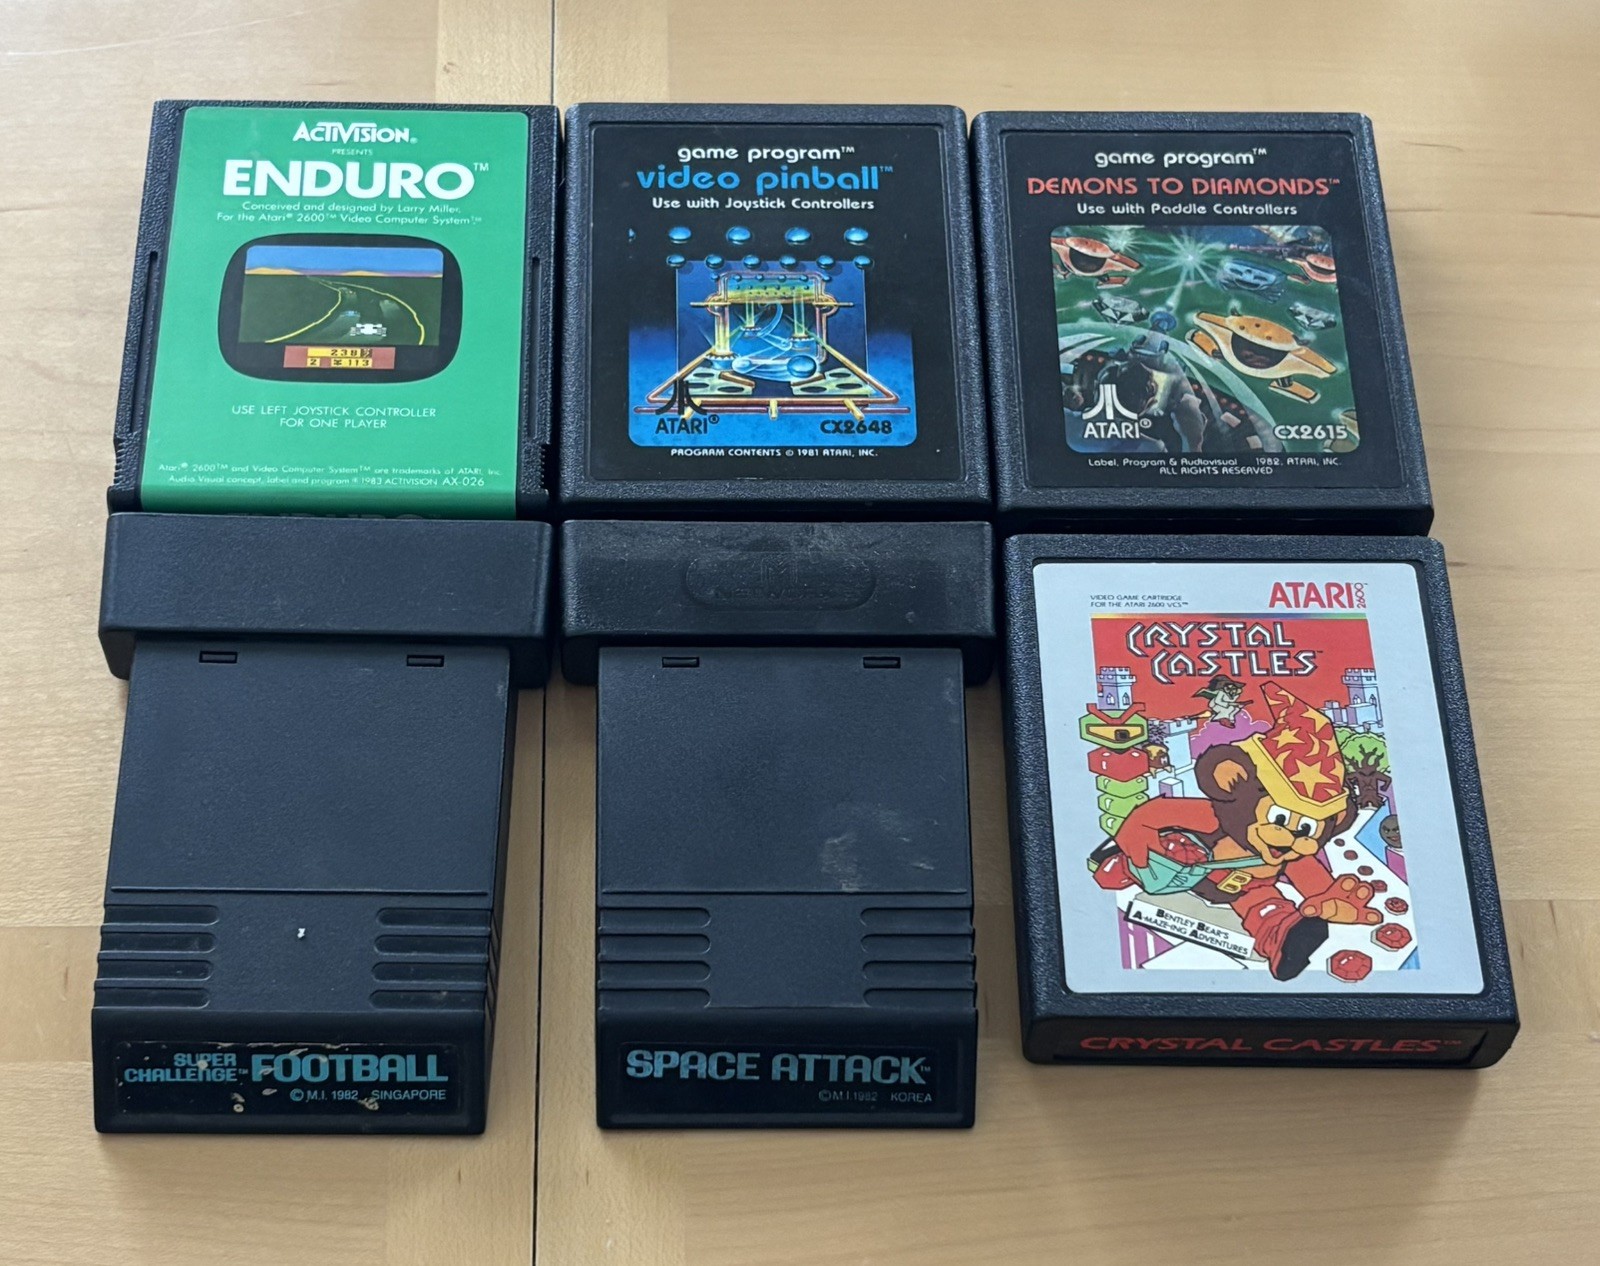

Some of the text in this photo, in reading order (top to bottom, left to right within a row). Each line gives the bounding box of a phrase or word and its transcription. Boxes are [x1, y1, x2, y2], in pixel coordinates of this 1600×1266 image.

[332, 148, 373, 156] PRESENTS
[677, 147, 739, 162] game
[1095, 151, 1155, 168] game
[636, 164, 740, 190] video
[1027, 177, 1138, 195] DEMONS
[1147, 178, 1183, 195] TO
[242, 201, 300, 211] Conceived
[303, 203, 325, 211] and
[328, 203, 377, 214] designed
[380, 203, 394, 214] by
[397, 204, 425, 214] Larry
[652, 197, 874, 212] Use with Joystick Controllers
[1077, 203, 1298, 216] Use with Paddle Controllers
[217, 212, 234, 221] For
[238, 212, 255, 222] the
[340, 214, 372, 223] Video
[375, 214, 429, 226] Computer
[231, 405, 436, 418] USE LEFT JOYSTICK CONTROLLER
[280, 418, 387, 429] FOR ONE PLAYER
[820, 419, 893, 435] CX2648
[1274, 424, 1348, 440] CX2615
[671, 448, 725, 457] PROGRAM
[728, 448, 781, 457] CONTENTS
[797, 448, 819, 457] 1981
[823, 448, 855, 458] ATARI,
[859, 449, 878, 457] INC.
[1123, 458, 1166, 468] Program
[1169, 458, 1178, 466] &
[1180, 458, 1238, 466] Audiovisual
[231, 465, 249, 473] and
[252, 465, 279, 473] Video
[282, 466, 325, 475] Computer
[392, 467, 441, 476] trademarks
[444, 467, 454, 475] of
[1159, 467, 1274, 475] ALL RIGHTS RESERVED
[169, 475, 195, 483] Audio
[198, 475, 225, 484] Visual
[226, 476, 264, 486] concept,
[267, 476, 289, 484] label
[291, 476, 308, 484] and
[311, 478, 350, 487] program
[361, 477, 382, 485] 1983
[384, 478, 438, 486] ACTIVISION
[442, 476, 485, 487] AX-026
[1268, 581, 1355, 609] ATARI
[1126, 622, 1296, 657] CRYSTAL
[1156, 909, 1230, 940] BENTLEY BEAR'S
[1132, 910, 1249, 956] A-MAZE-ING ADVENTURES
[1080, 1037, 1252, 1051] CRYSTAL
[173, 1053, 237, 1067] SUPER
[626, 1049, 760, 1081] SPACE
[252, 1053, 448, 1083] FOOTBALL
[331, 1089, 359, 1100] 1982
[371, 1089, 447, 1100] SINGAPORE
[853, 1091, 878, 1102] 1982
[890, 1091, 932, 1103] KOREA
